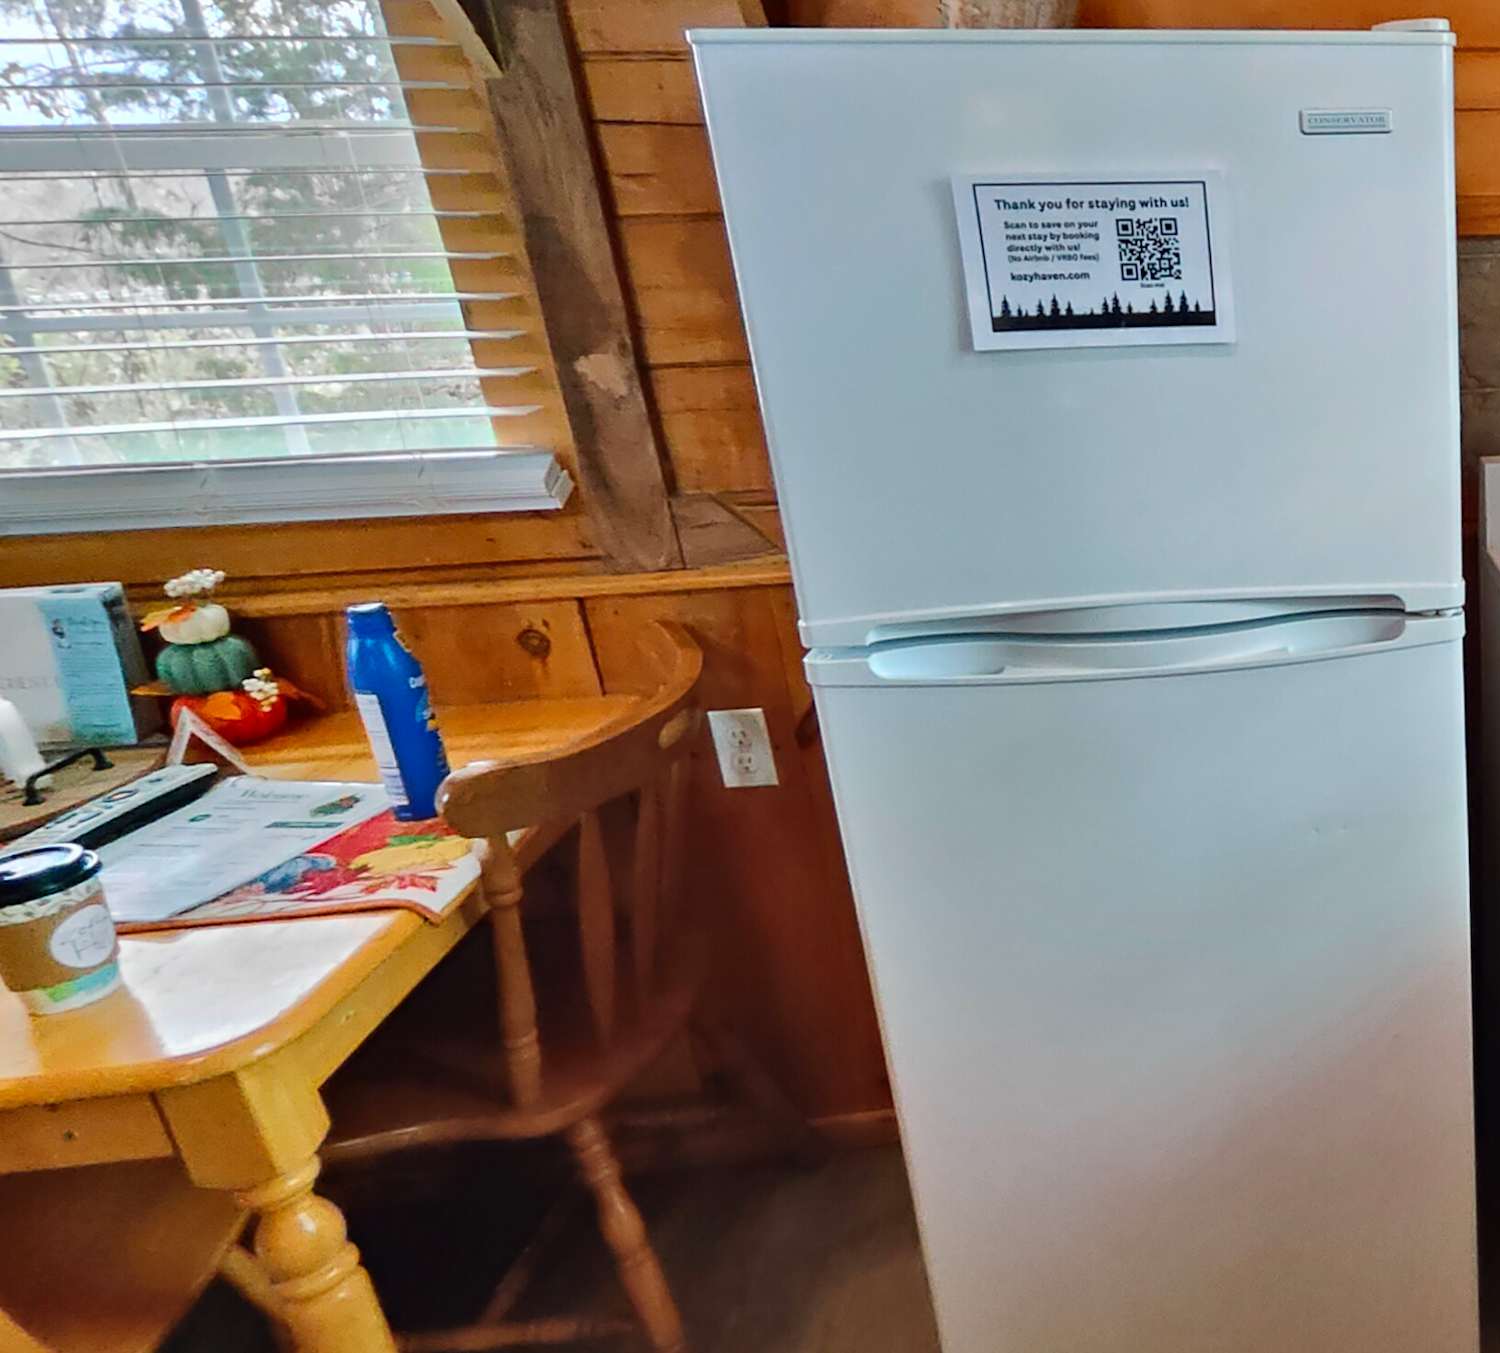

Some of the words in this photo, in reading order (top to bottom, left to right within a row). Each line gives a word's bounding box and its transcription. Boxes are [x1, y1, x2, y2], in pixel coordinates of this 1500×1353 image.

[994, 198, 1036, 211] Thank
[1038, 200, 1063, 213] you
[1065, 198, 1085, 210] for
[1088, 197, 1136, 212] staying
[1139, 197, 1168, 209] with
[1170, 196, 1190, 209] us!
[1003, 220, 1027, 230] Scan
[1028, 220, 1040, 229] to
[1041, 221, 1062, 229] save
[1063, 221, 1076, 229] on
[1077, 220, 1098, 230] your
[1005, 232, 1027, 241] next
[1028, 232, 1048, 242] stay
[1049, 232, 1061, 242] by
[1062, 231, 1100, 242] booking
[1006, 243, 1042, 254] directly
[1044, 243, 1066, 252] with
[1010, 271, 1091, 283] kozyhaven.com
